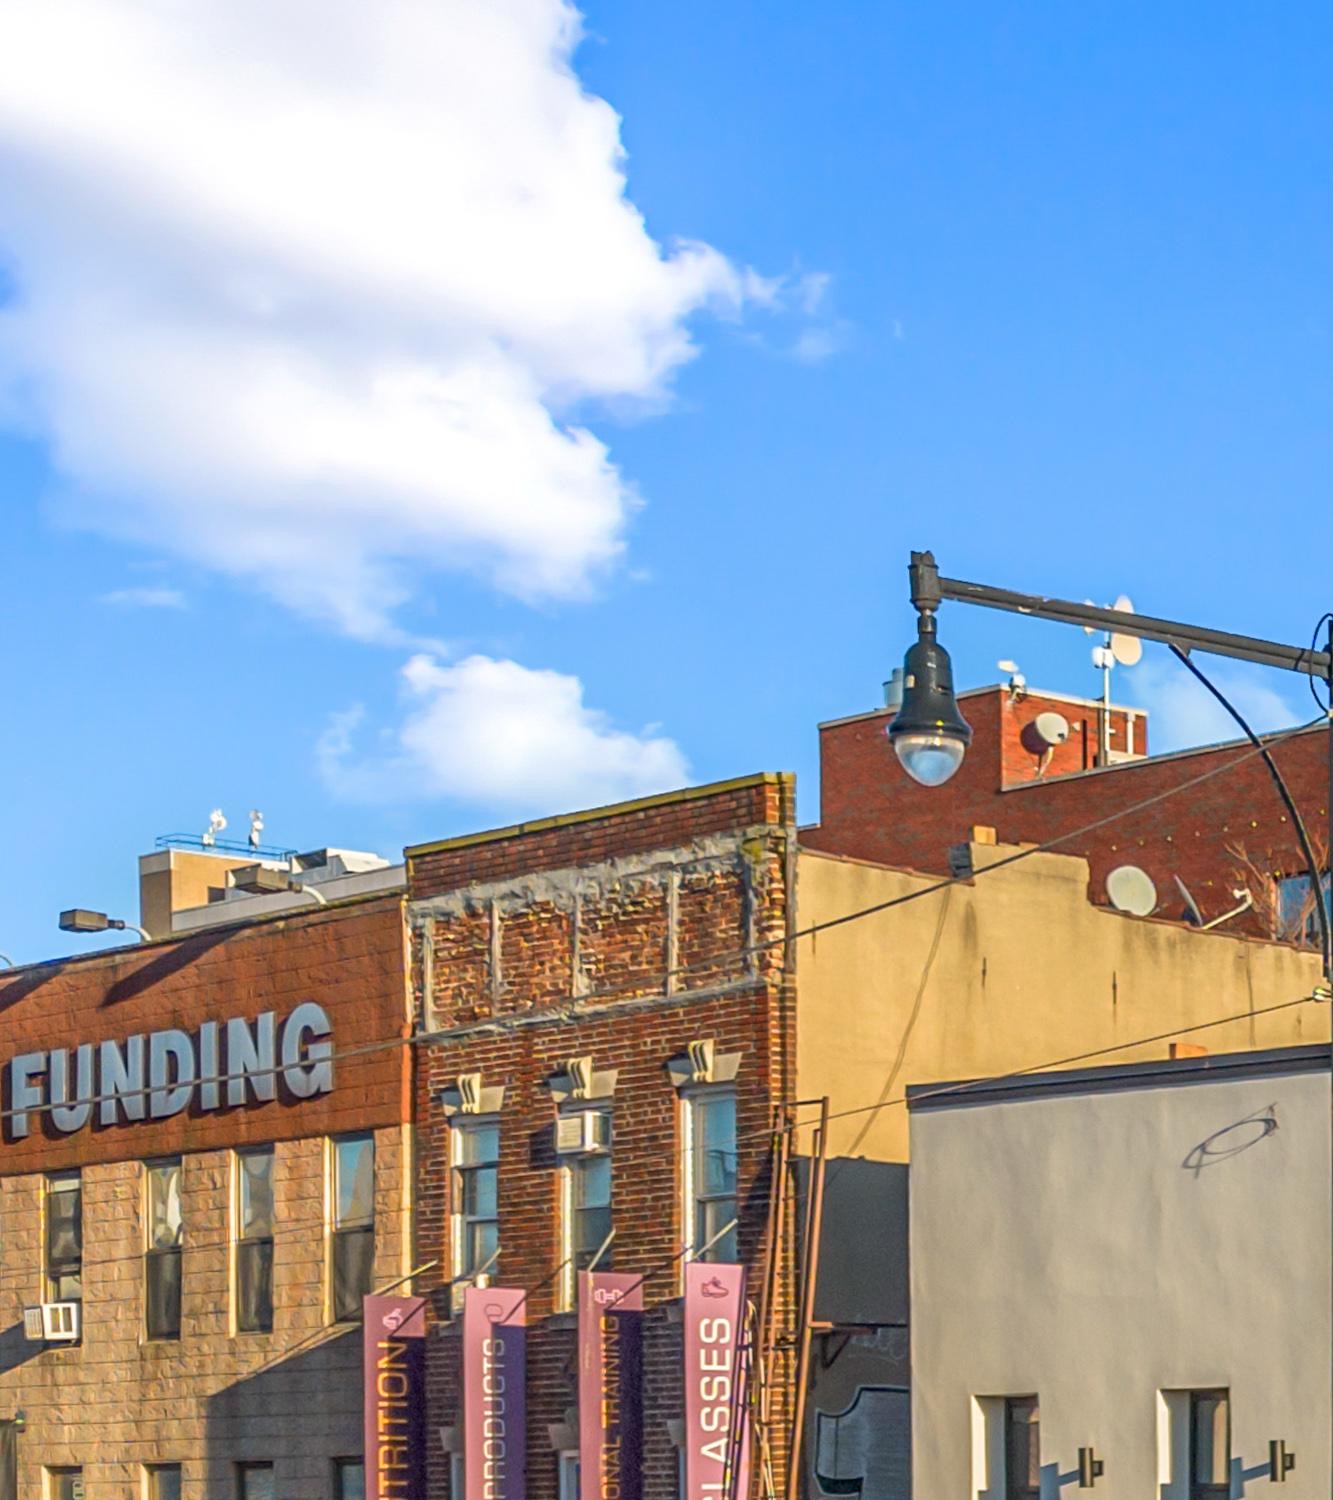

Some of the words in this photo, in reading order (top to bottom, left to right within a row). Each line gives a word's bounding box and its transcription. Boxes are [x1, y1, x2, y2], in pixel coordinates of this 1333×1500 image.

[10, 1002, 333, 1139] FUNDING
[482, 1337, 506, 1500] PRODUCTS
[601, 1315, 621, 1429] TRAINING
